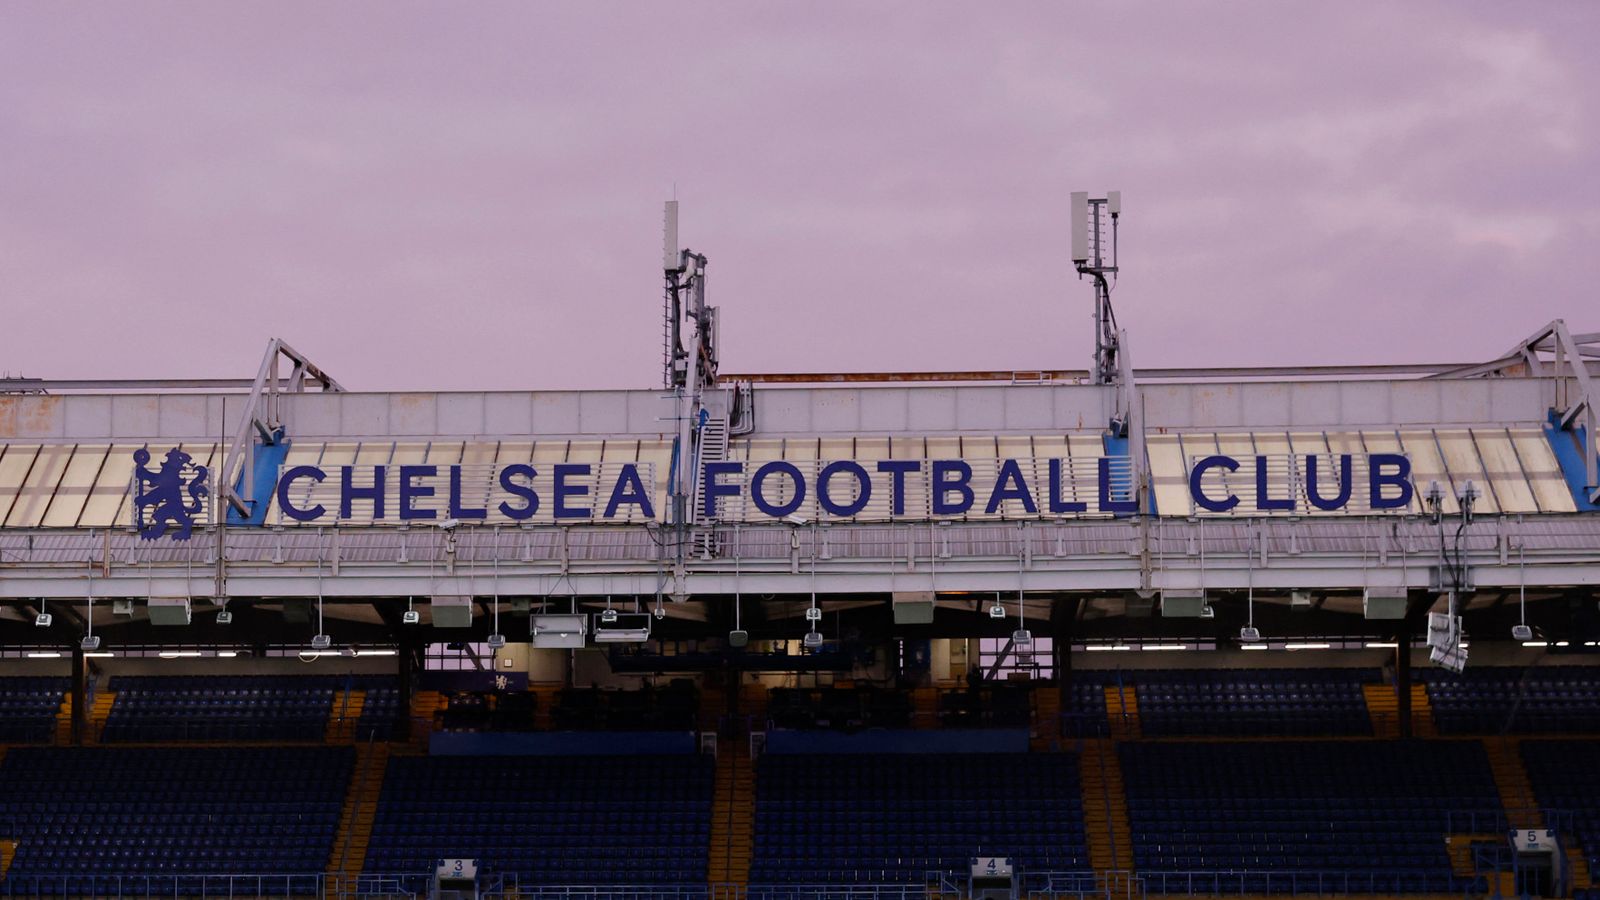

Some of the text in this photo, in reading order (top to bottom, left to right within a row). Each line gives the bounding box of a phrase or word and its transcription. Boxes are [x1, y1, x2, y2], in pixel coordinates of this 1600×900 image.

[277, 454, 1413, 519] CHELSEA FOOTBALL CLUB
[1528, 830, 1536, 842] 5
[454, 860, 462, 870] 3
[988, 858, 996, 870] 4
